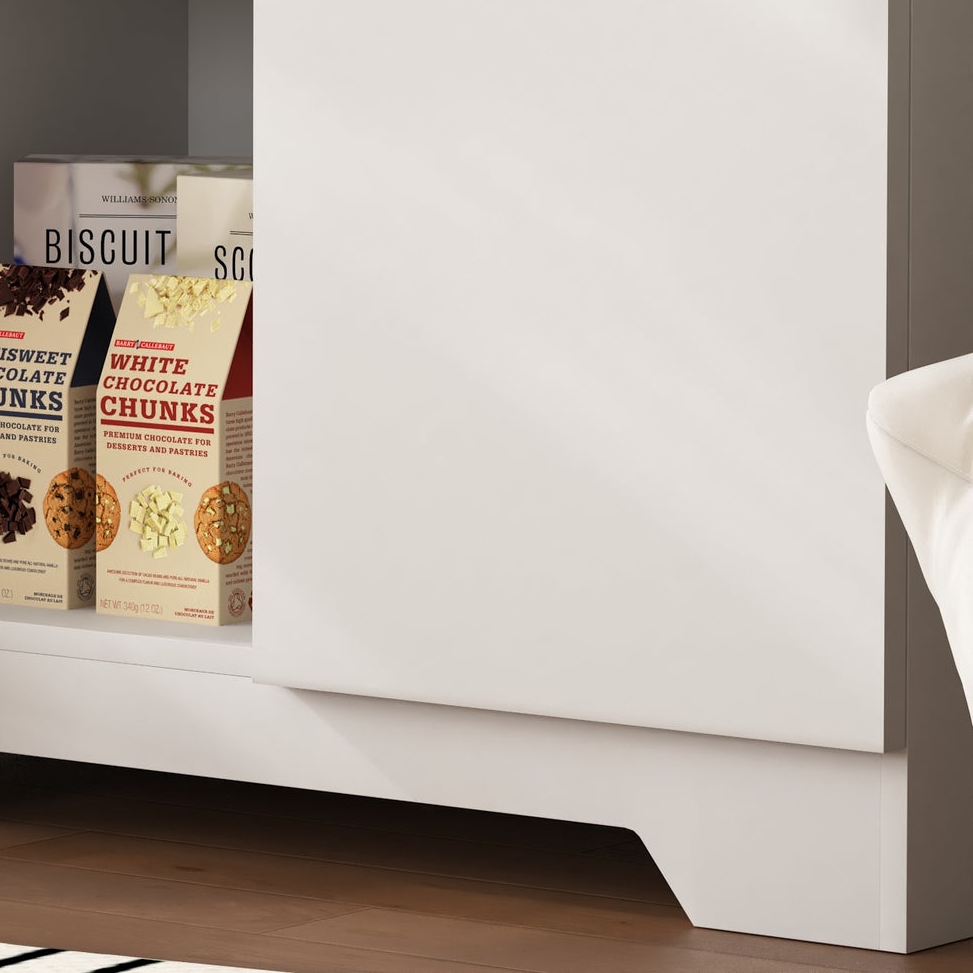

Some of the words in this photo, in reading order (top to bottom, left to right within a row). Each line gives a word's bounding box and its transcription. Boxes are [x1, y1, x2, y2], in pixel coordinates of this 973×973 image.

[45, 228, 172, 266] BISCUIT
[214, 244, 253, 282] SC
[115, 340, 135, 348] BARRY
[140, 341, 174, 351] CALLEBAUT
[110, 353, 189, 375] WHITE
[102, 375, 218, 398] CHOCOLATE
[100, 395, 215, 425] CHUNKS
[0, 432, 17, 441] AND
[18, 434, 57, 444] PASTRIES
[44, 425, 60, 433] FOR
[103, 430, 142, 441] PREMIUM
[144, 434, 193, 445] CHOCOLATE
[195, 438, 212, 447] FOR
[106, 442, 147, 452] DESSERTS
[149, 445, 167, 454] AND
[168, 448, 209, 458] PASTRIES
[17, 455, 42, 474] BAKING
[122, 466, 150, 483] PERFECT
[152, 466, 166, 474] FOR
[168, 469, 193, 488] BAKING
